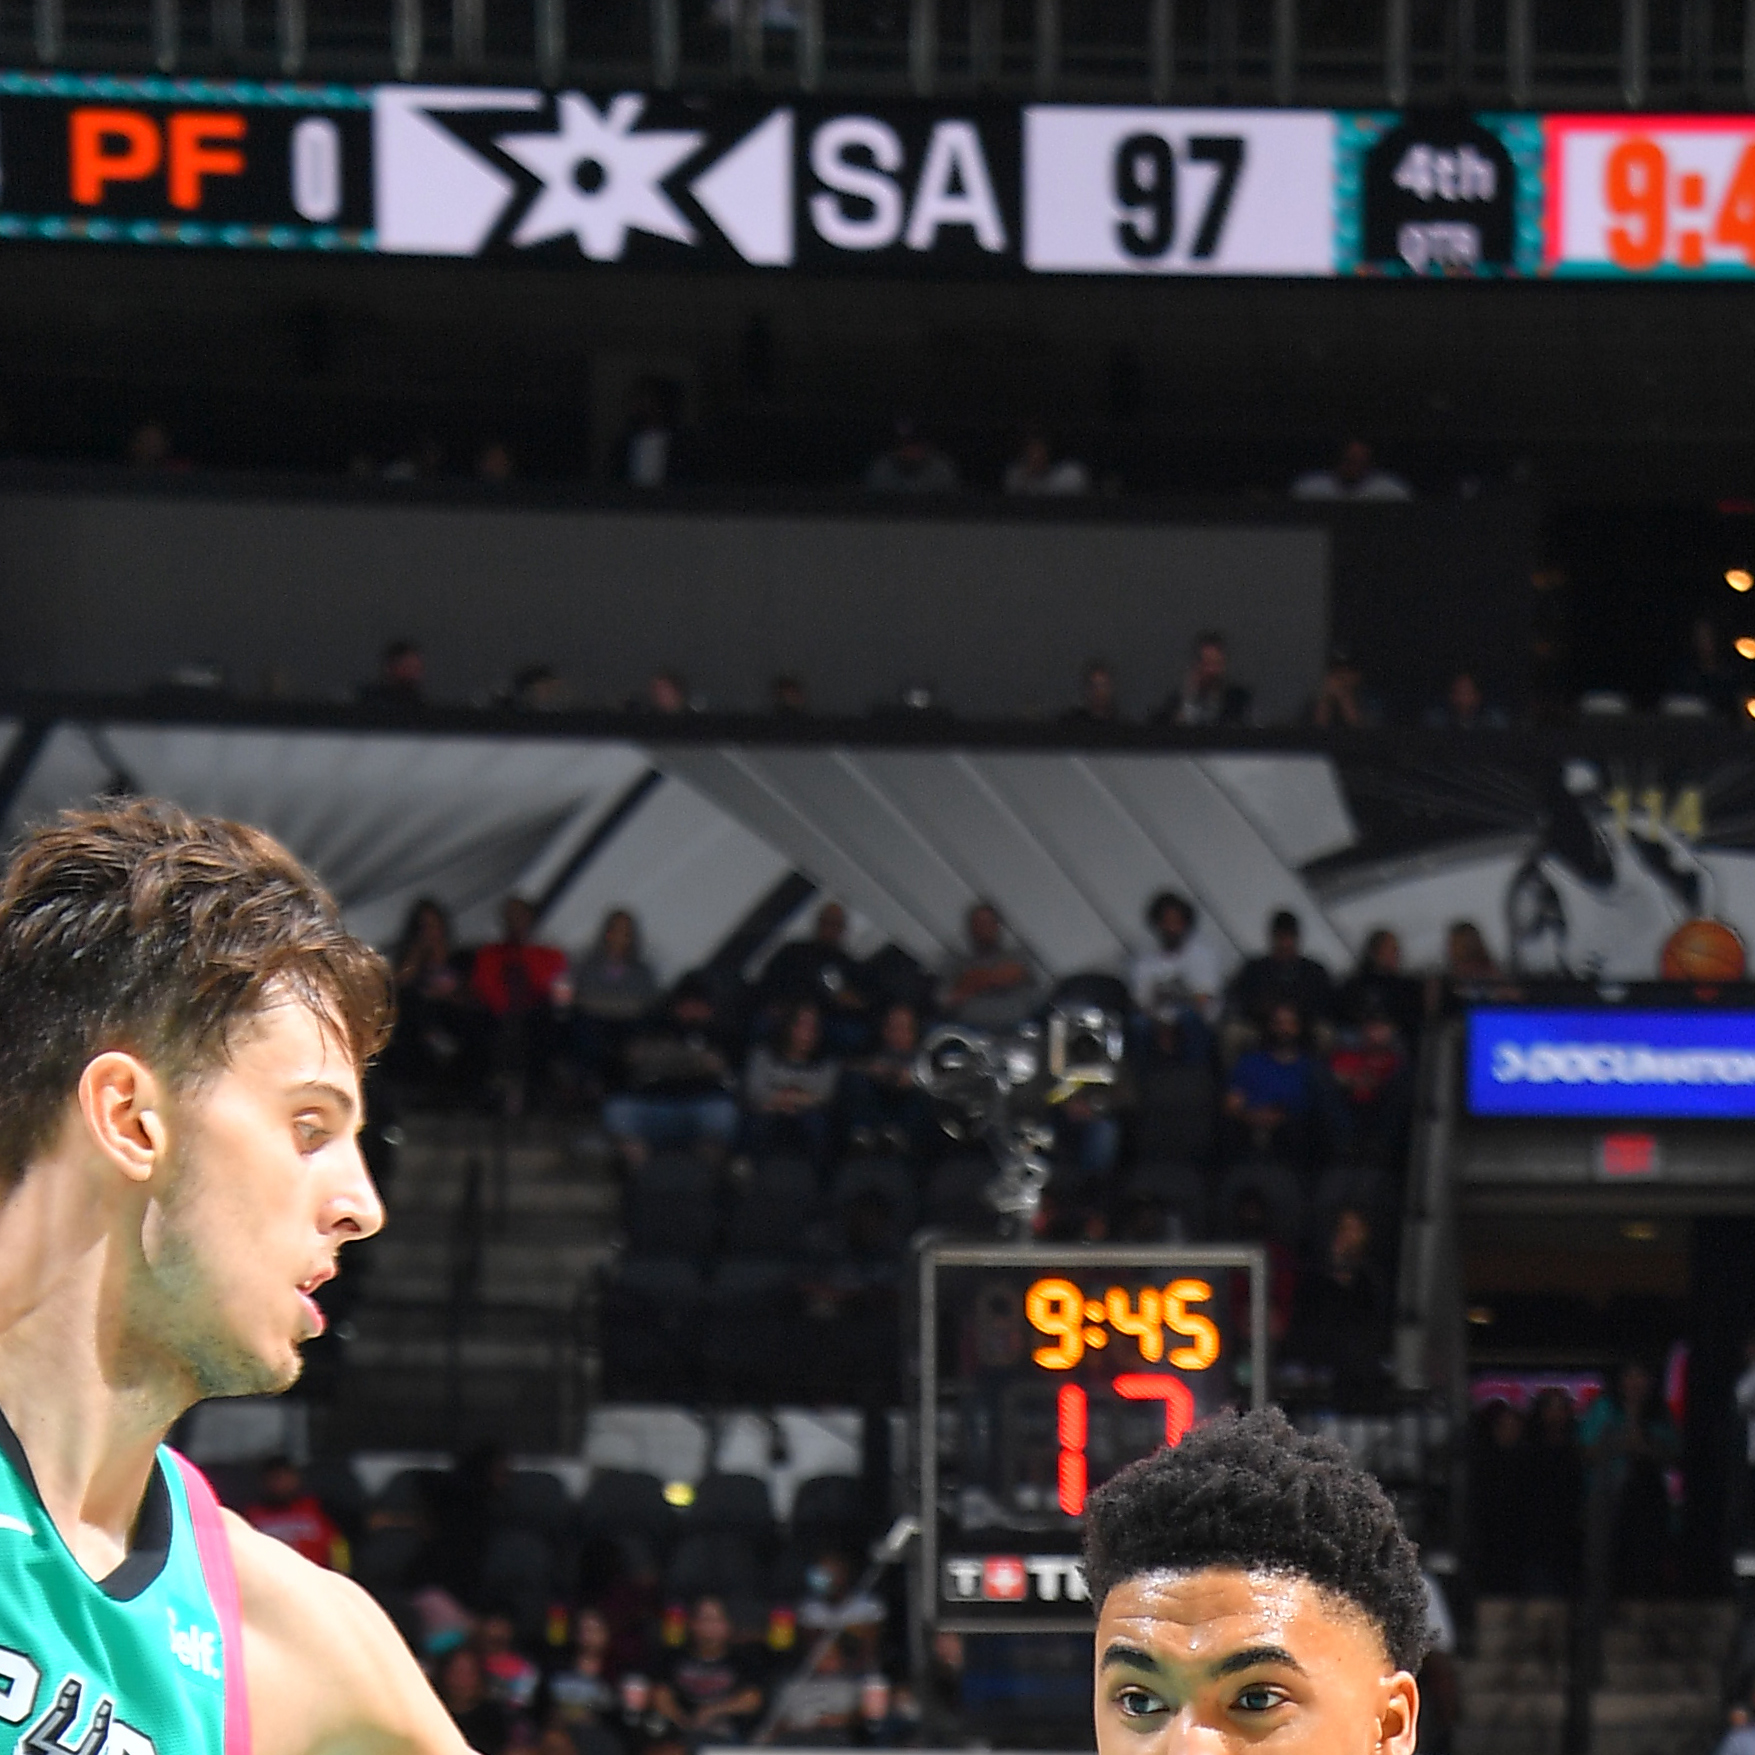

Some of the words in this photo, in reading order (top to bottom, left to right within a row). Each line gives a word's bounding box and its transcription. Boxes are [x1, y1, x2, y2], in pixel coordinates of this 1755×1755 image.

[68, 107, 248, 210] PF
[810, 118, 1005, 250] SA
[1111, 132, 1247, 268] 97
[1394, 147, 1496, 202] 4th
[1025, 1278, 1221, 1371] 9:45
